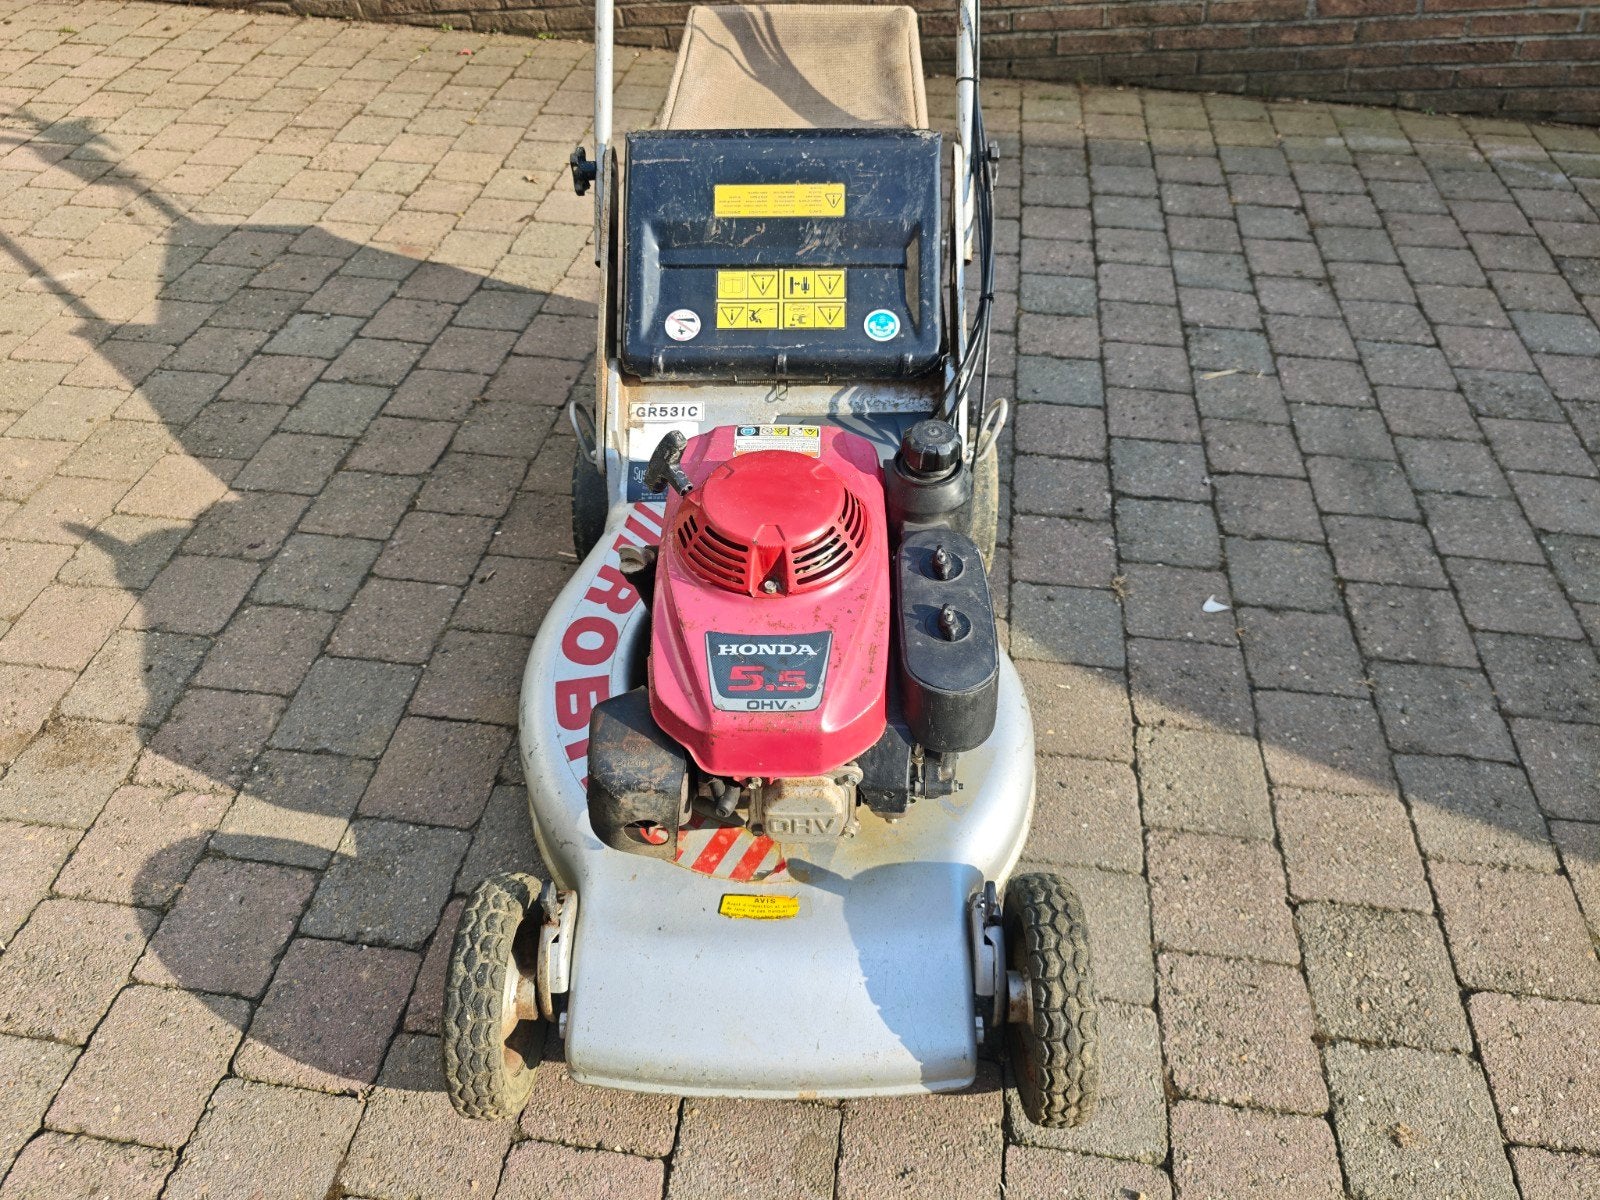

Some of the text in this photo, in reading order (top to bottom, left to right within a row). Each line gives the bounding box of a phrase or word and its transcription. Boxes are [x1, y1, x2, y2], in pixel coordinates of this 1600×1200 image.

[636, 406, 698, 417] GR531C
[717, 643, 818, 656] HONDA
[727, 664, 808, 692] 5.5
[746, 700, 789, 711] OHV
[767, 816, 837, 836] OHV
